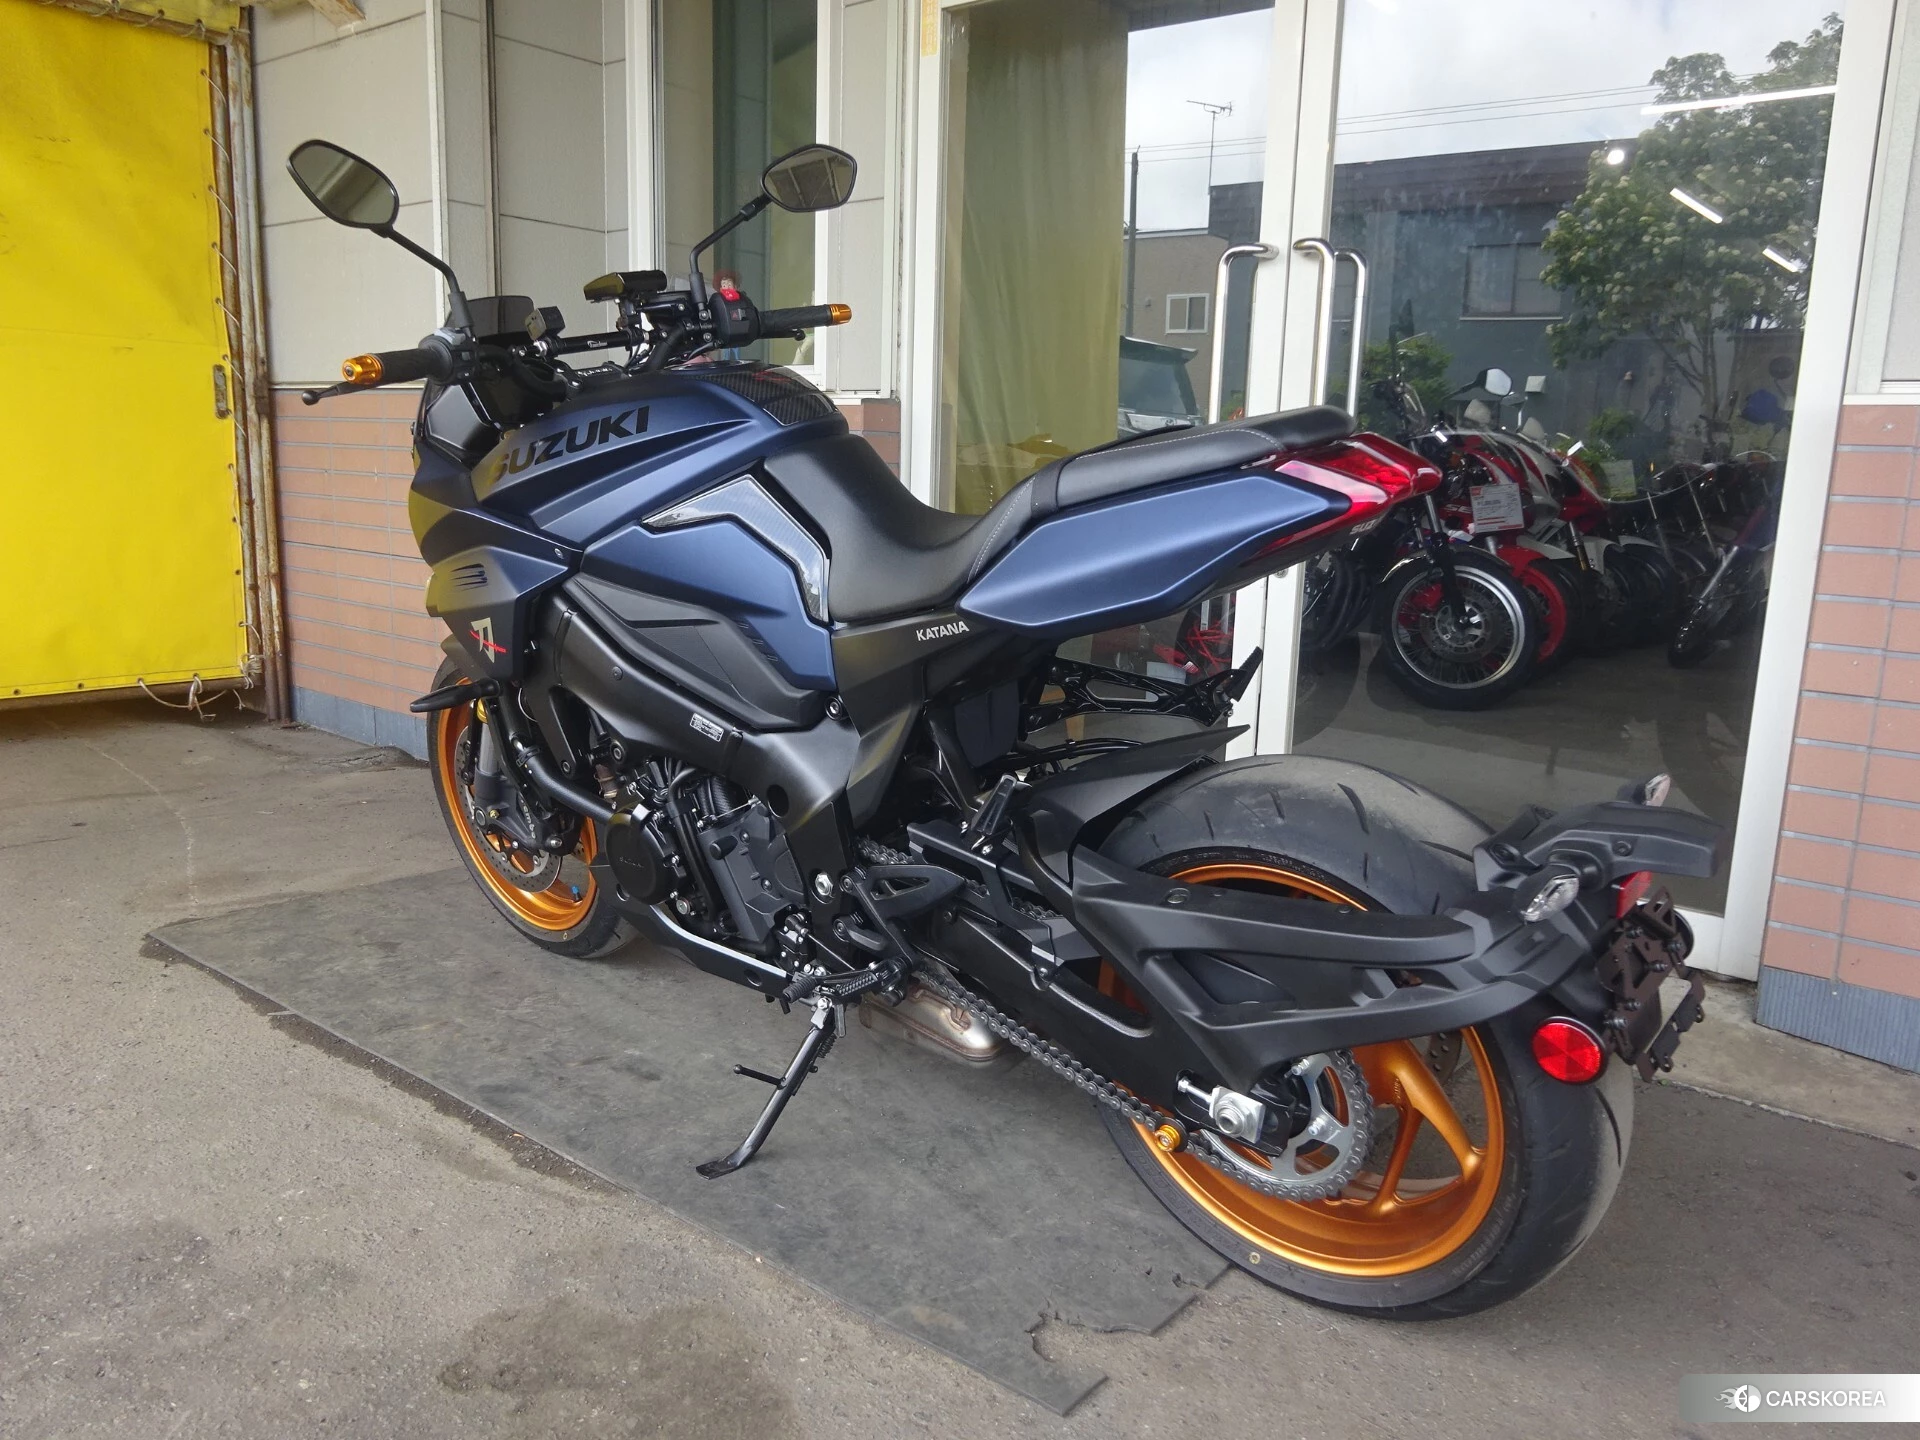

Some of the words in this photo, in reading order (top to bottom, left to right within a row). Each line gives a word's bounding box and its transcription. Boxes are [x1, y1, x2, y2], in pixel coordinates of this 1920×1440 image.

[488, 405, 650, 485] SUZUKI
[1444, 503, 1472, 514] SE
[915, 620, 970, 641] KATANA
